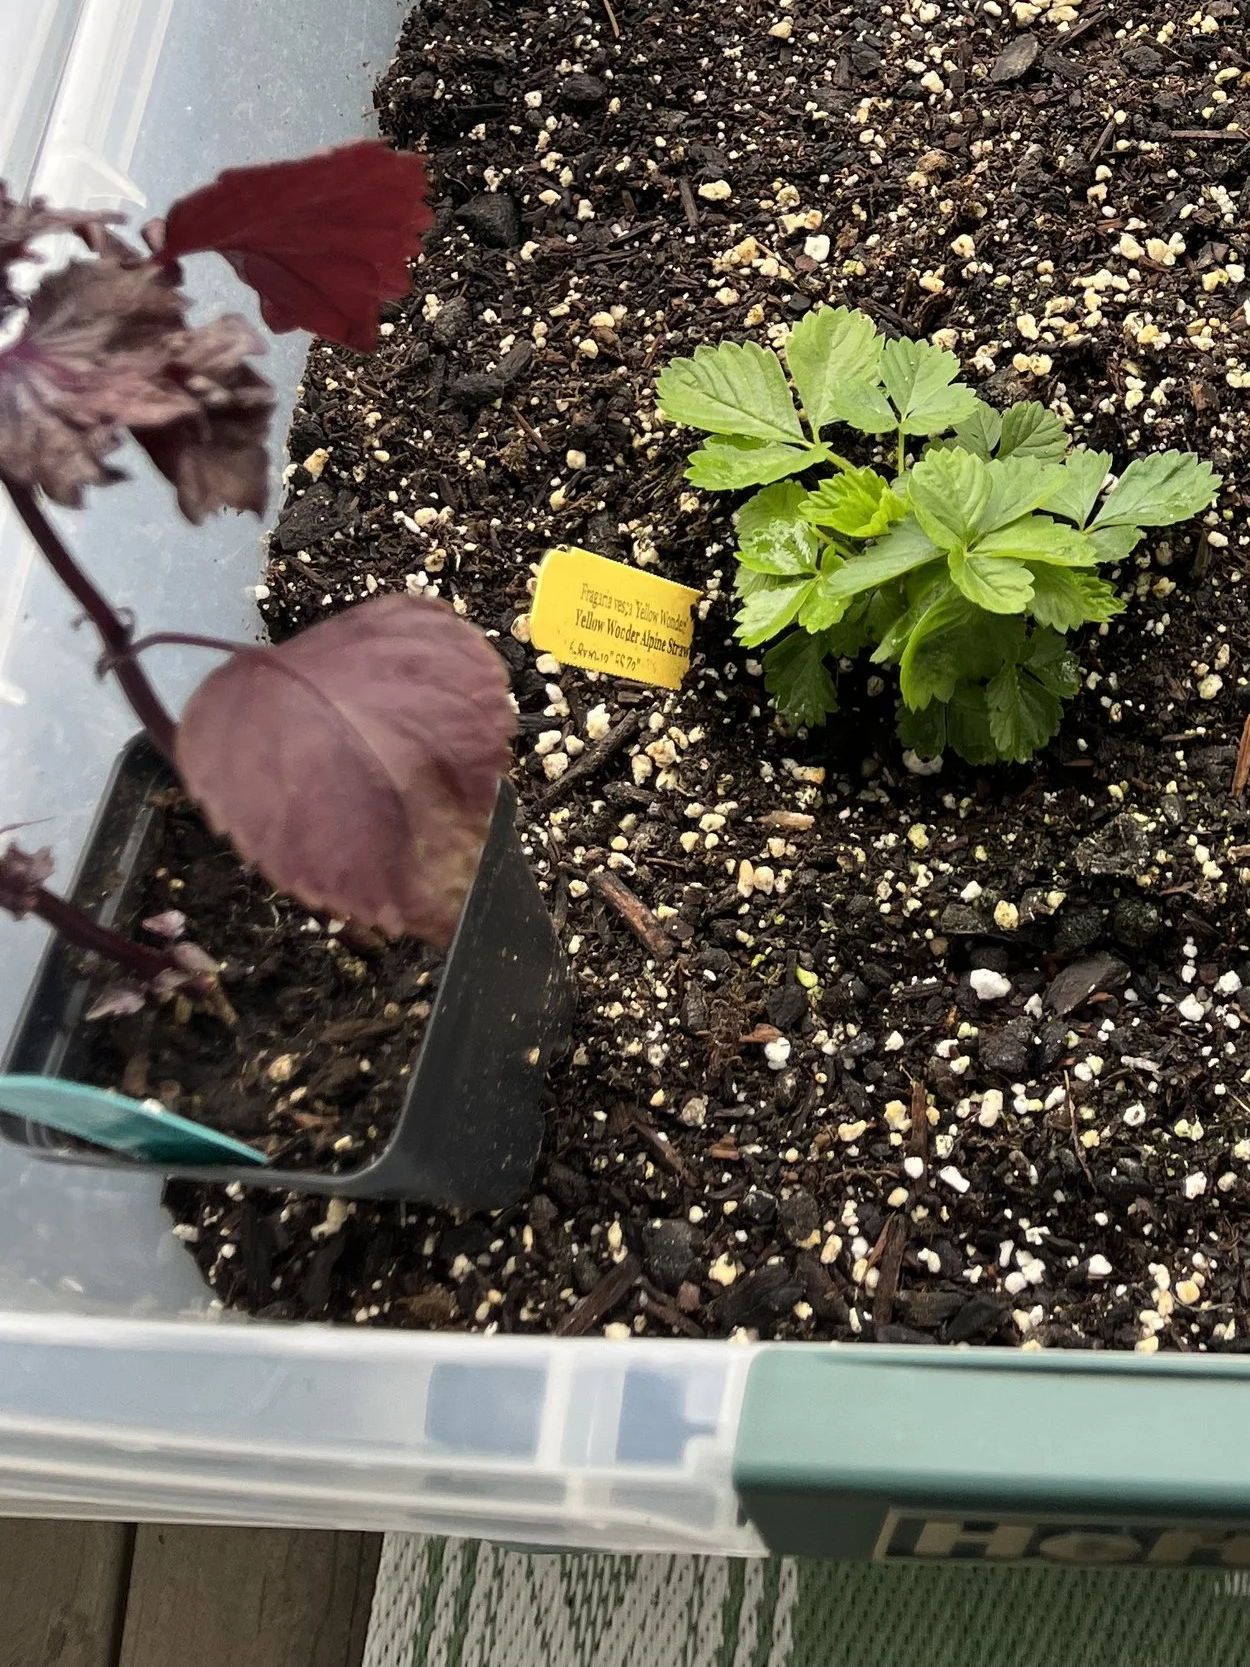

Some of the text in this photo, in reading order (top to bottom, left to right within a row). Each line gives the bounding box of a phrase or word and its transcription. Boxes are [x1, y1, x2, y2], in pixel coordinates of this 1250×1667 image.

[575, 608, 605, 632] Yellow
[606, 618, 640, 643] Wonder
[640, 629, 667, 654] Alpine
